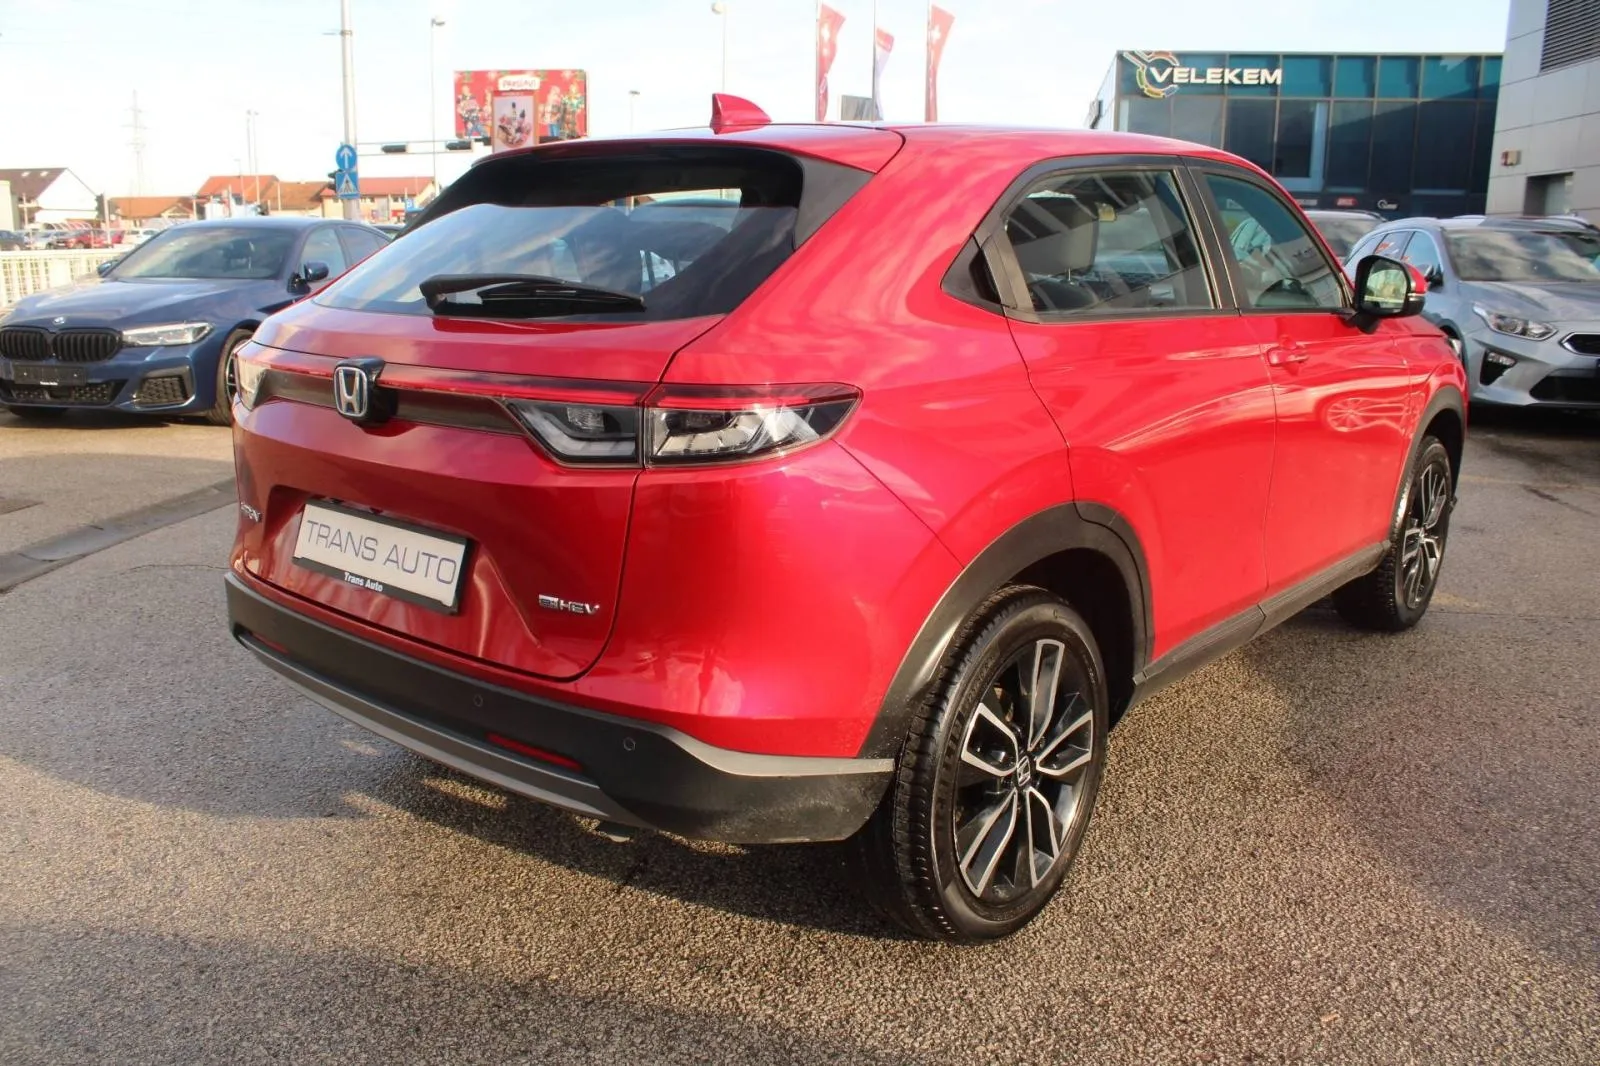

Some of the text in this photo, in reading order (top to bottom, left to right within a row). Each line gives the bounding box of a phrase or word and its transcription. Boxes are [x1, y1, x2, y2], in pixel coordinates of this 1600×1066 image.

[1150, 67, 1282, 85] VELEKEM
[307, 520, 457, 584] TRANS AUTO
[344, 572, 383, 592] Trans Auto
